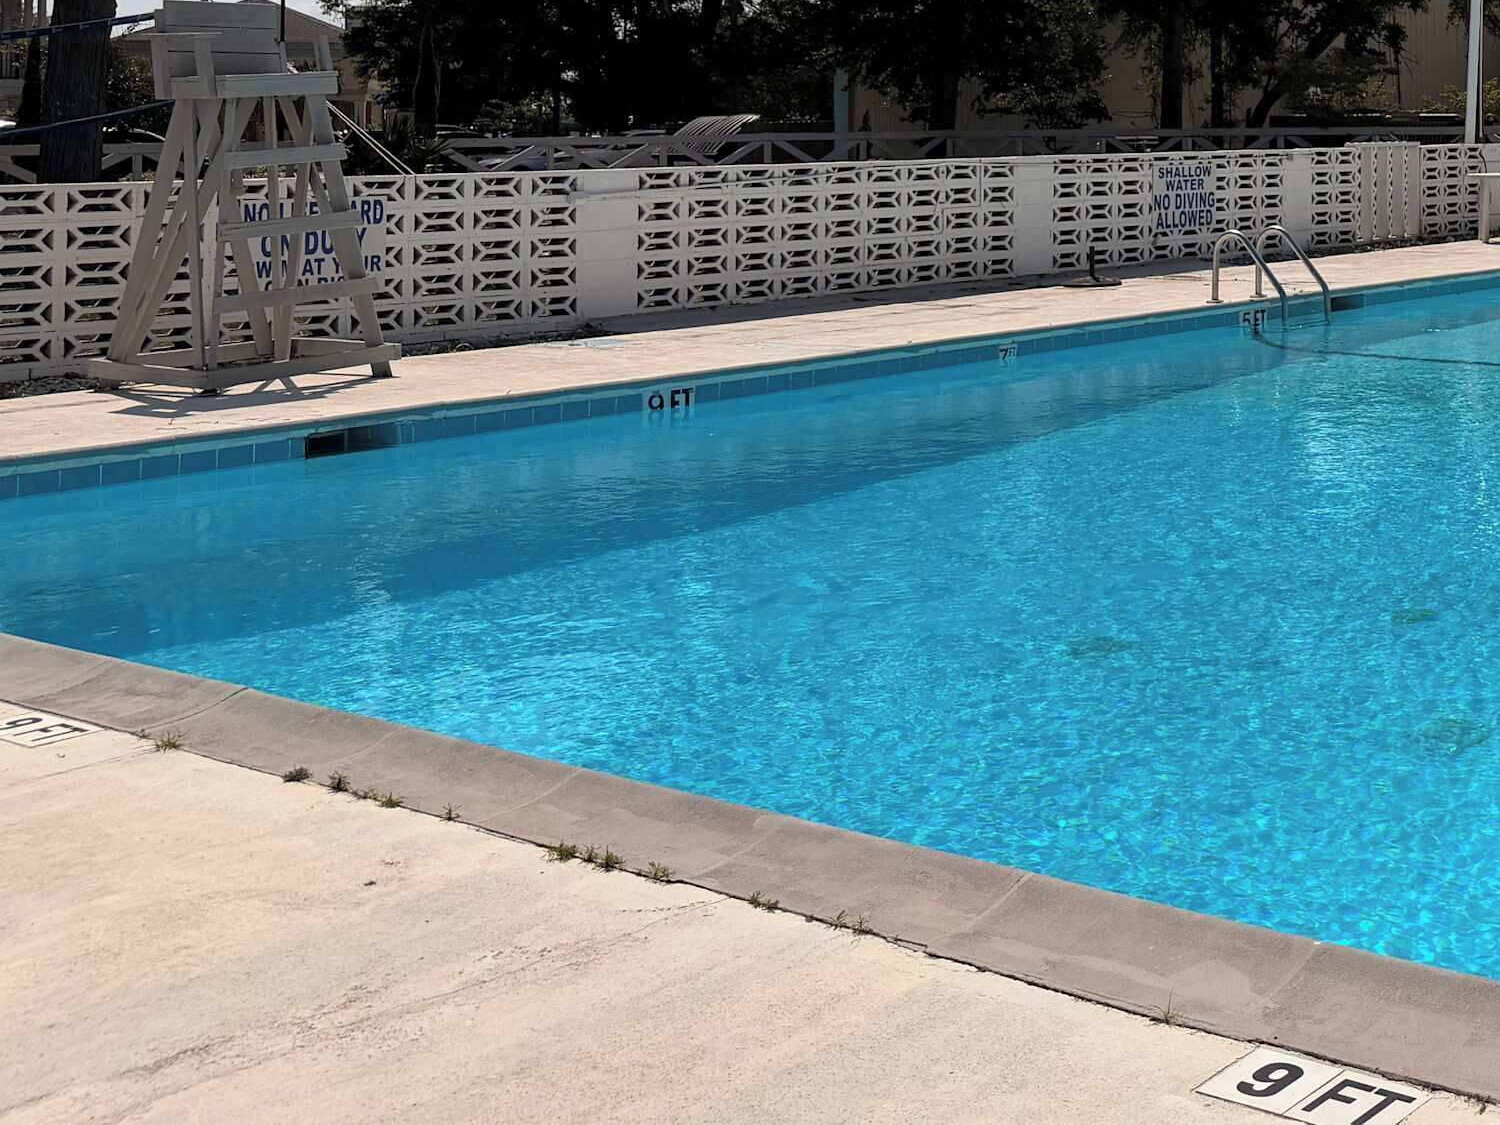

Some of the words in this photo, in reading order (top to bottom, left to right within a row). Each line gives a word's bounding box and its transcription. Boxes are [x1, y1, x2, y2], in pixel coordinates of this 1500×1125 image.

[1158, 165, 1212, 179] SHALLOW
[1166, 178, 1205, 192] WATER
[1154, 194, 1171, 211] NO
[1175, 192, 1216, 210] DIVING
[243, 202, 270, 223] NO
[1156, 209, 1213, 230] ALLOWED
[301, 257, 325, 276] AT
[12, 723, 90, 743] FT
[1236, 1062, 1305, 1098] 9
[1301, 1078, 1417, 1125] FT
